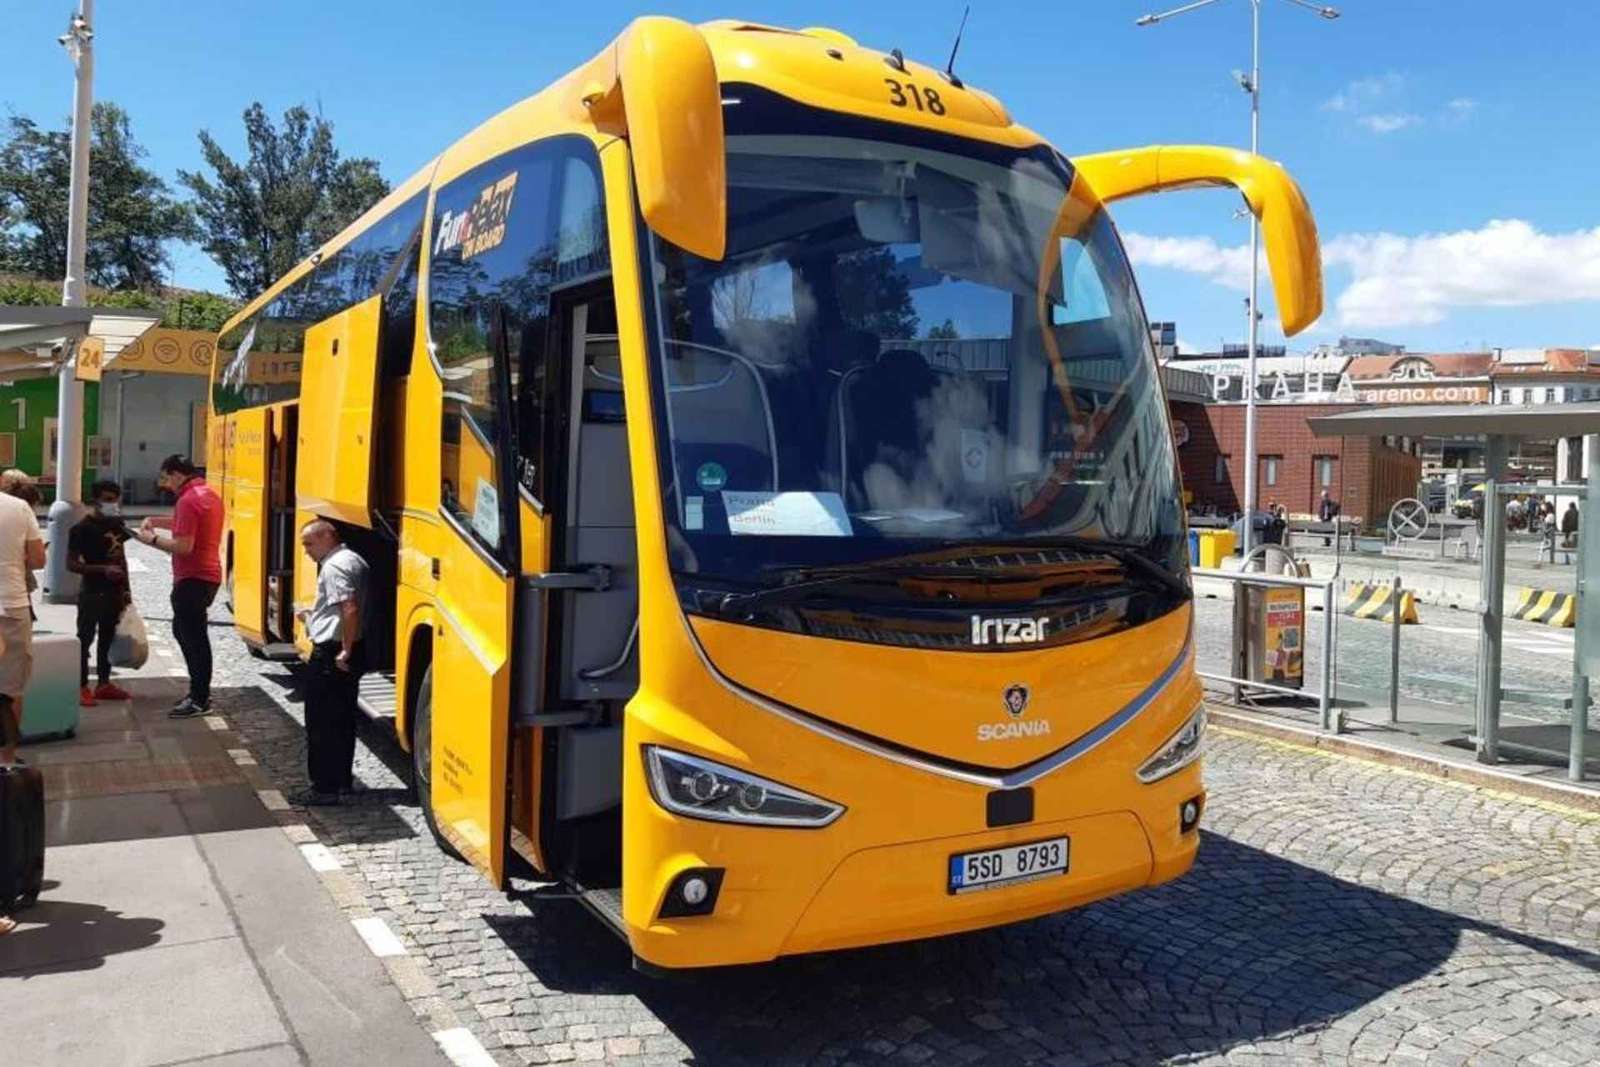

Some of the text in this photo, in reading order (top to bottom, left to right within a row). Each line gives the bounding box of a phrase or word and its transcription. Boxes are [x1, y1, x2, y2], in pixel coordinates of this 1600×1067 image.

[885, 78, 946, 116] 318
[81, 347, 100, 368] 24
[1212, 372, 1355, 401] PRAHA
[10, 397, 26, 430] 1
[971, 614, 1050, 645] Irizar
[977, 720, 1050, 741] SCANIA
[967, 843, 1060, 881] 5SD 8793
